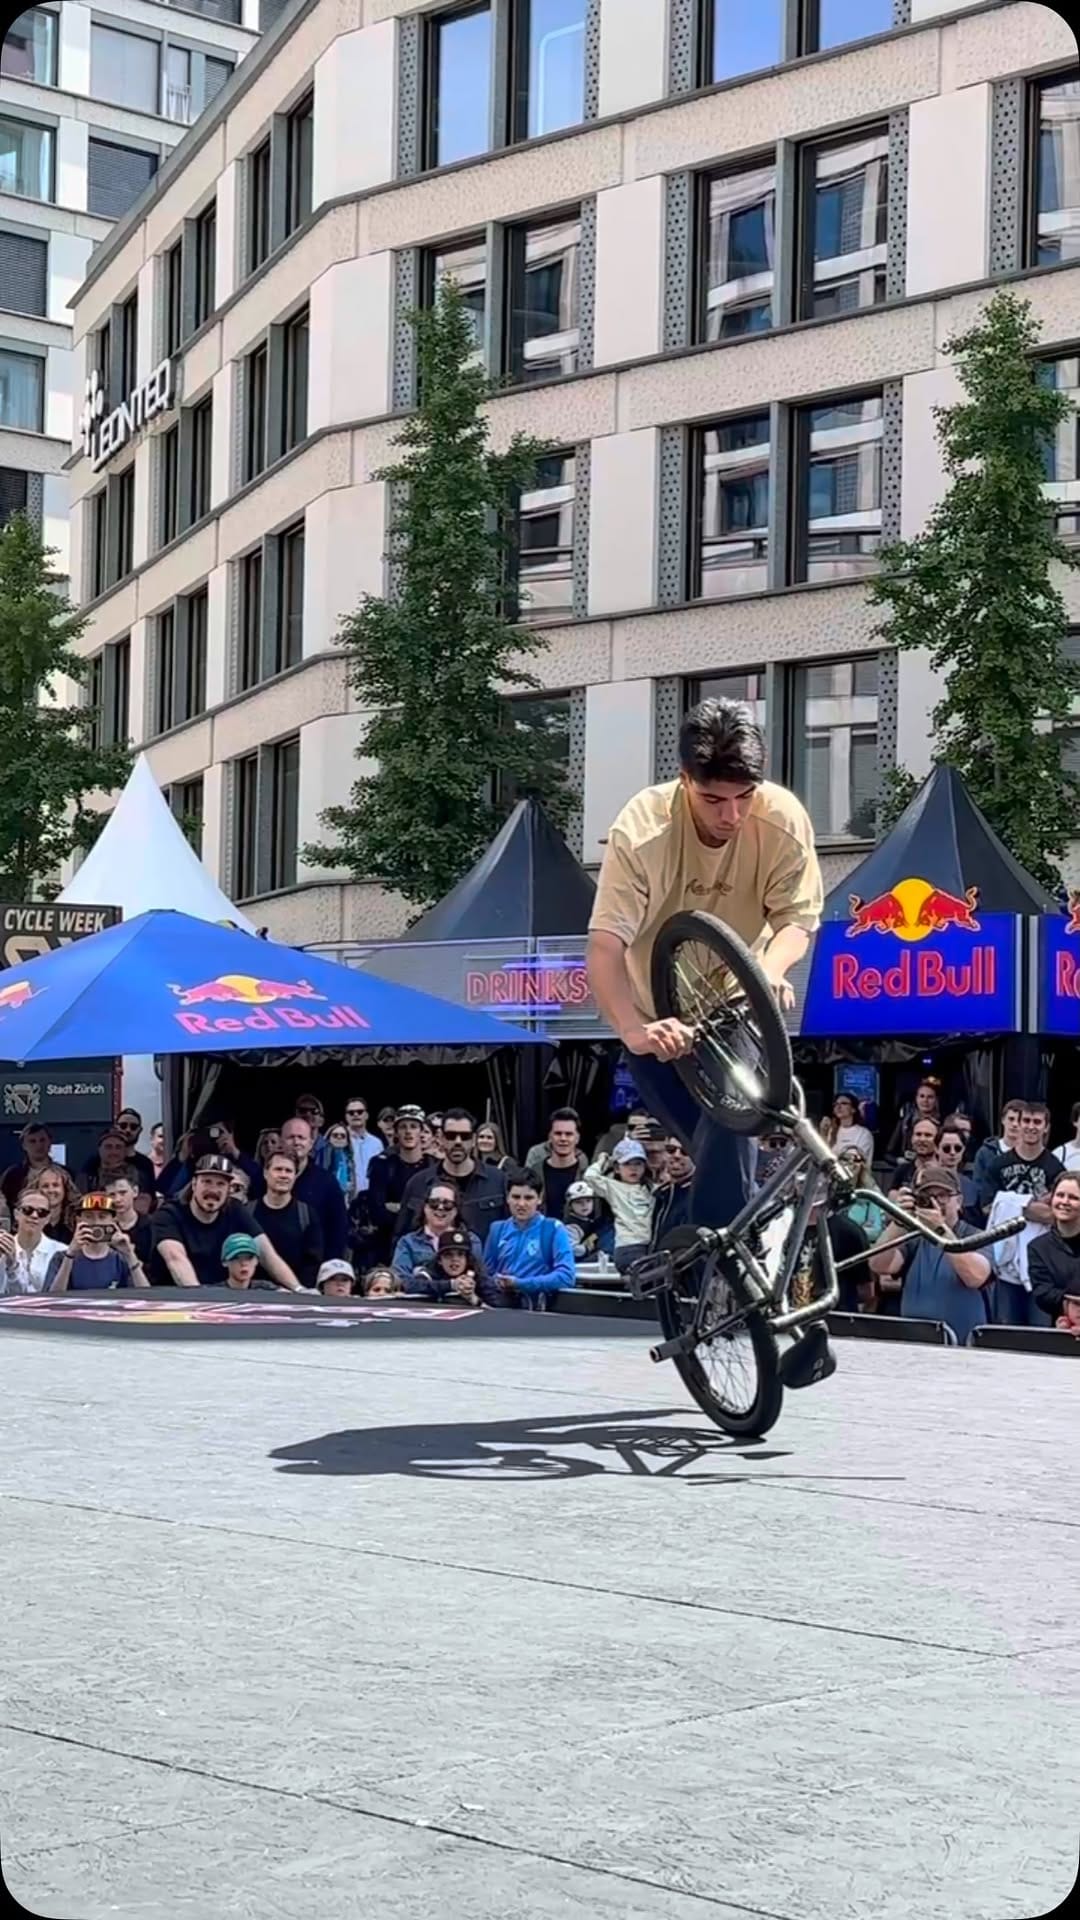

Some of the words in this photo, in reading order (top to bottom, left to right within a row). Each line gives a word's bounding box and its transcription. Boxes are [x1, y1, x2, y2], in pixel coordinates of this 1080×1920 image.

[92, 358, 170, 473] LEONTEQ
[4, 909, 54, 931] CYCLE
[59, 911, 107, 932] WEEK
[466, 968, 588, 1003] DRINKS
[832, 949, 911, 999] Red
[917, 945, 996, 997] Bull
[174, 1007, 280, 1034] Red
[273, 1005, 371, 1028] Bull
[46, 1084, 73, 1095] Stadt
[74, 1083, 105, 1095] Zürich
